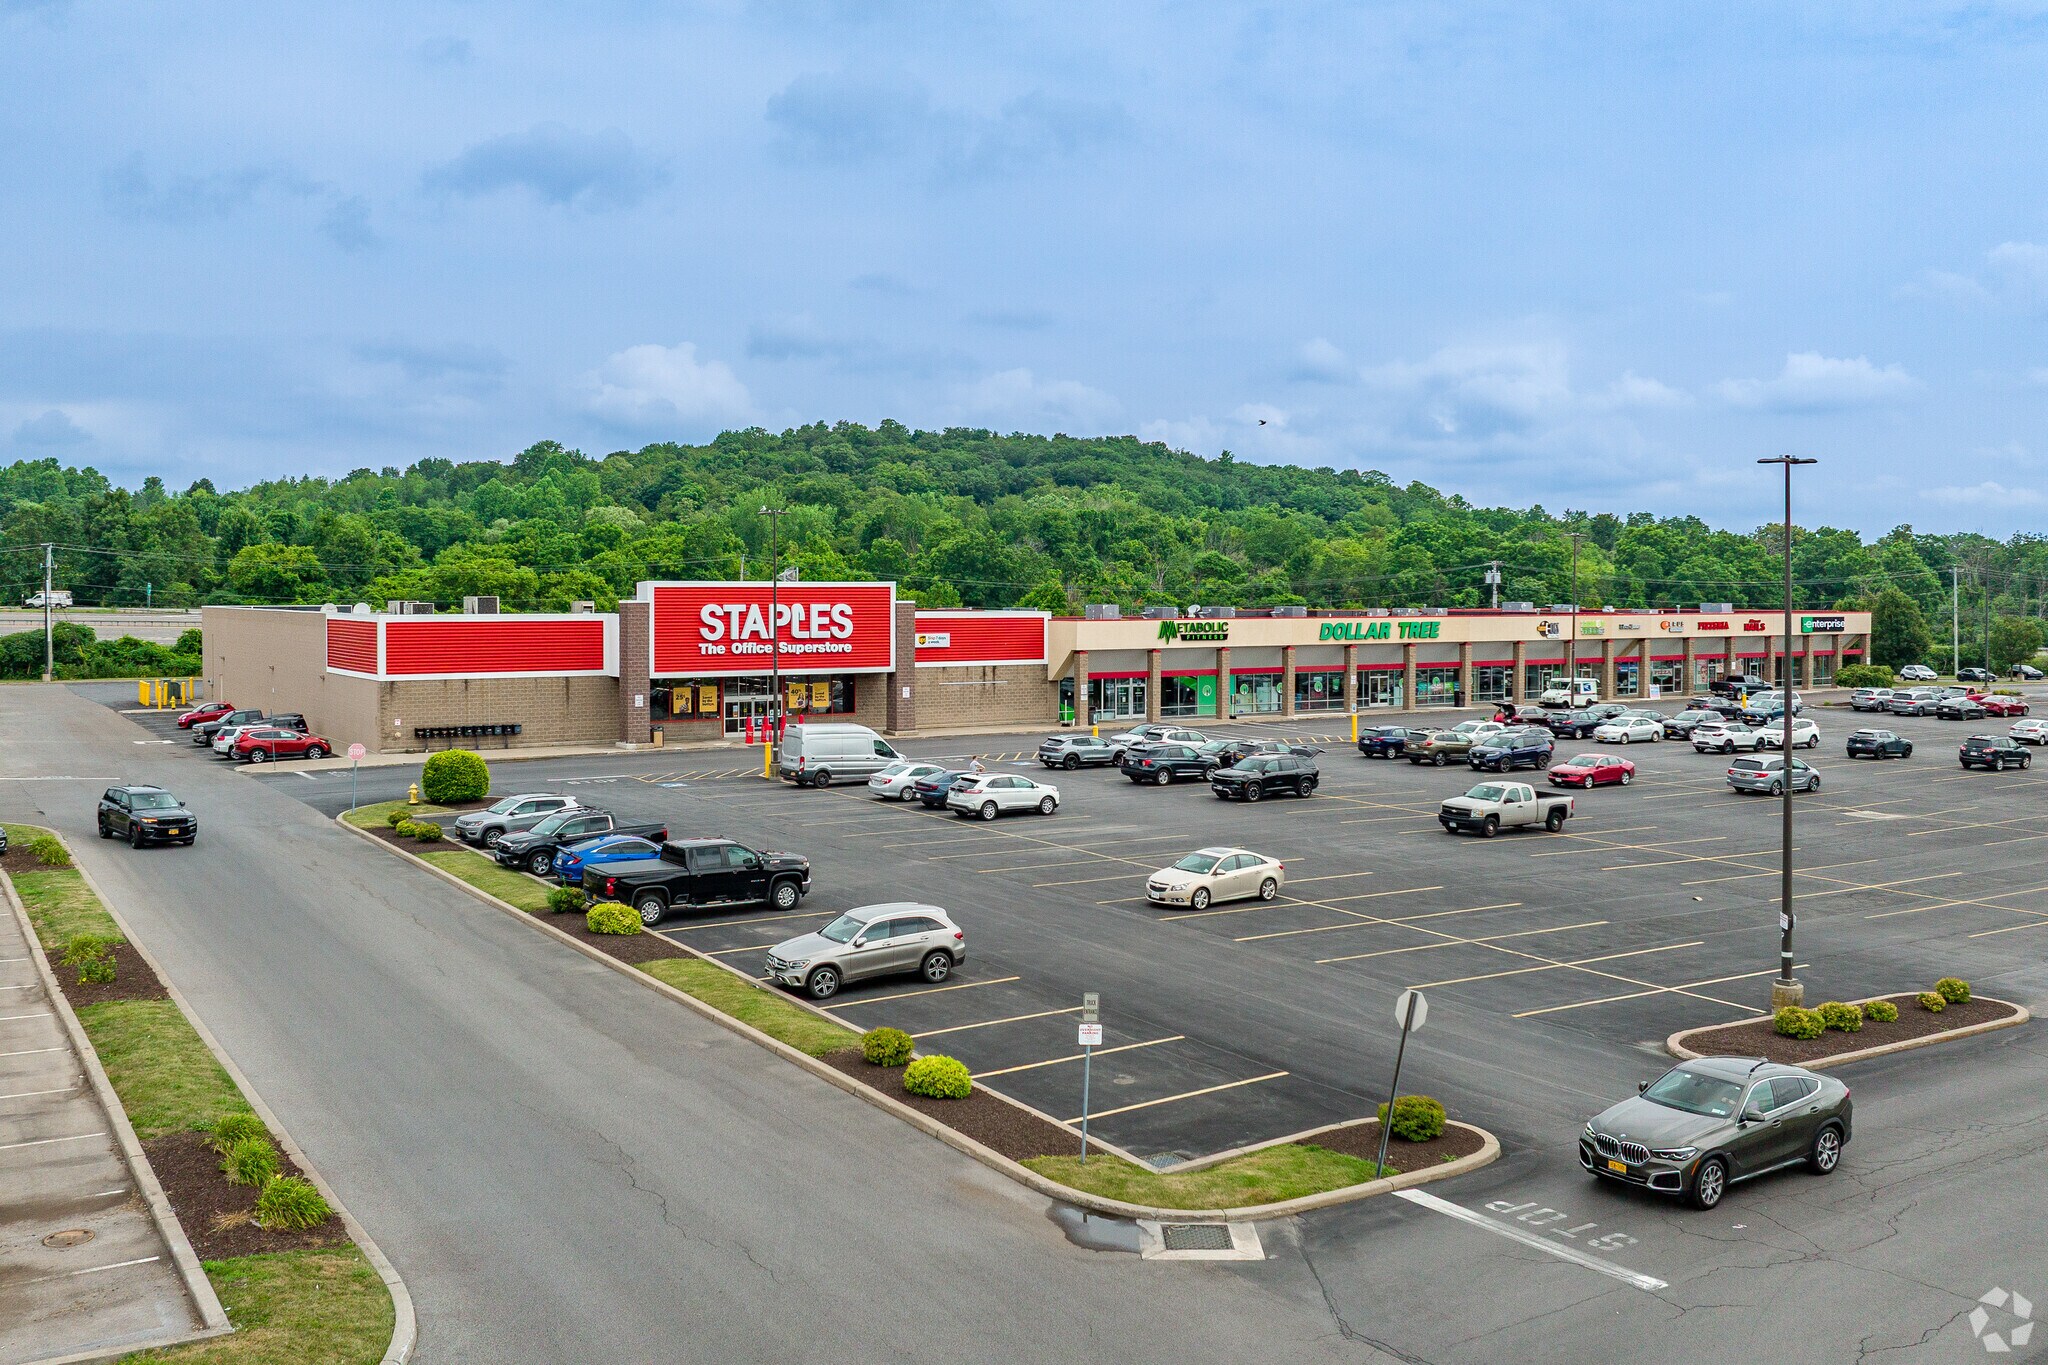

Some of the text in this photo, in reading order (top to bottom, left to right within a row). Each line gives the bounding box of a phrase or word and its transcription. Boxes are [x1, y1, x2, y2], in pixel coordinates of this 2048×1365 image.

[699, 603, 854, 641] STAPLES
[1319, 621, 1441, 641] DOLLAR TREE
[1743, 622, 1766, 632] NAILS
[1804, 619, 1845, 630] enterprise
[1157, 620, 1229, 645] METABOLIC
[698, 641, 853, 655] The Office Superstore
[1485, 1201, 1639, 1251] STOP
